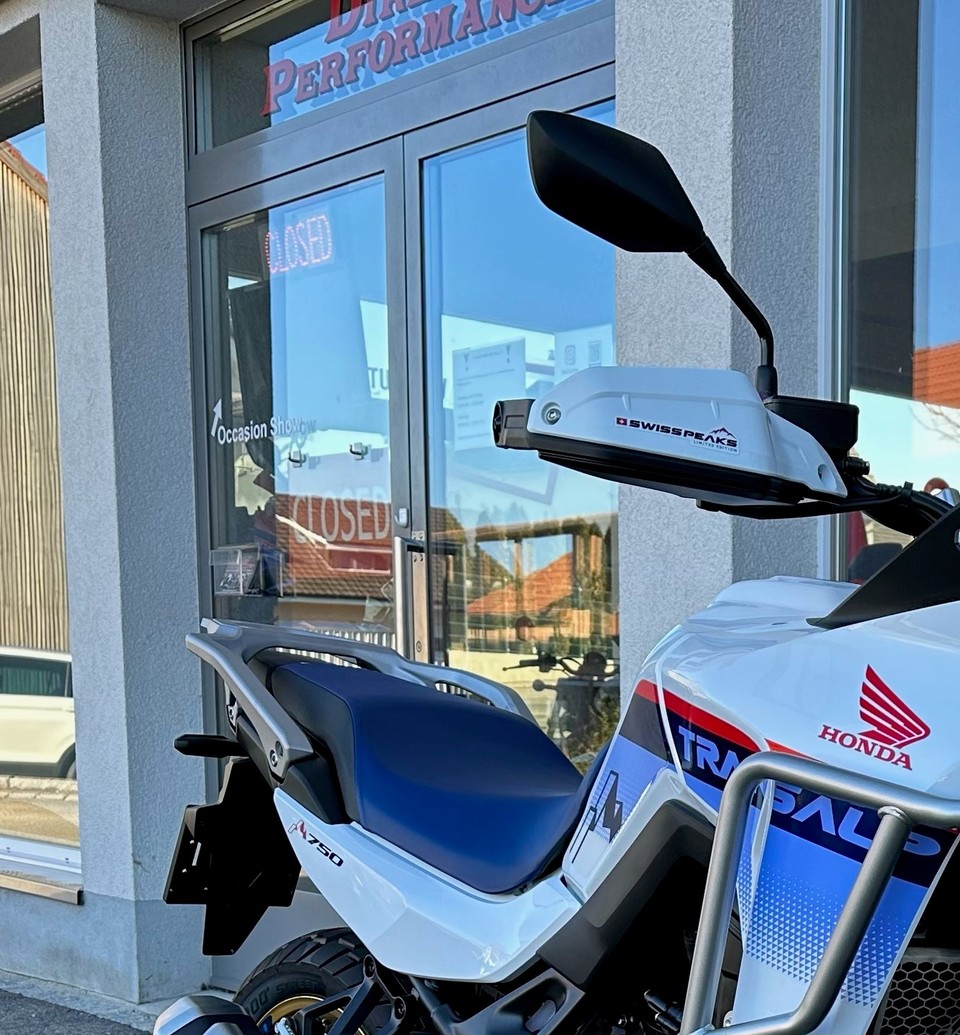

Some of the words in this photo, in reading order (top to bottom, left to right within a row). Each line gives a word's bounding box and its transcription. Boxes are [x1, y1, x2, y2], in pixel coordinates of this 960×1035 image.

[260, 0, 561, 116] PERFORMAN
[265, 214, 333, 274] CLOSED
[217, 421, 267, 445] Occasion
[629, 420, 737, 448] SWISSPEAKS
[693, 440, 714, 448] LIMITED
[716, 444, 738, 453] EDITION
[292, 486, 391, 543] CLOSED
[818, 725, 912, 770] HONDA
[308, 833, 343, 867] 750
